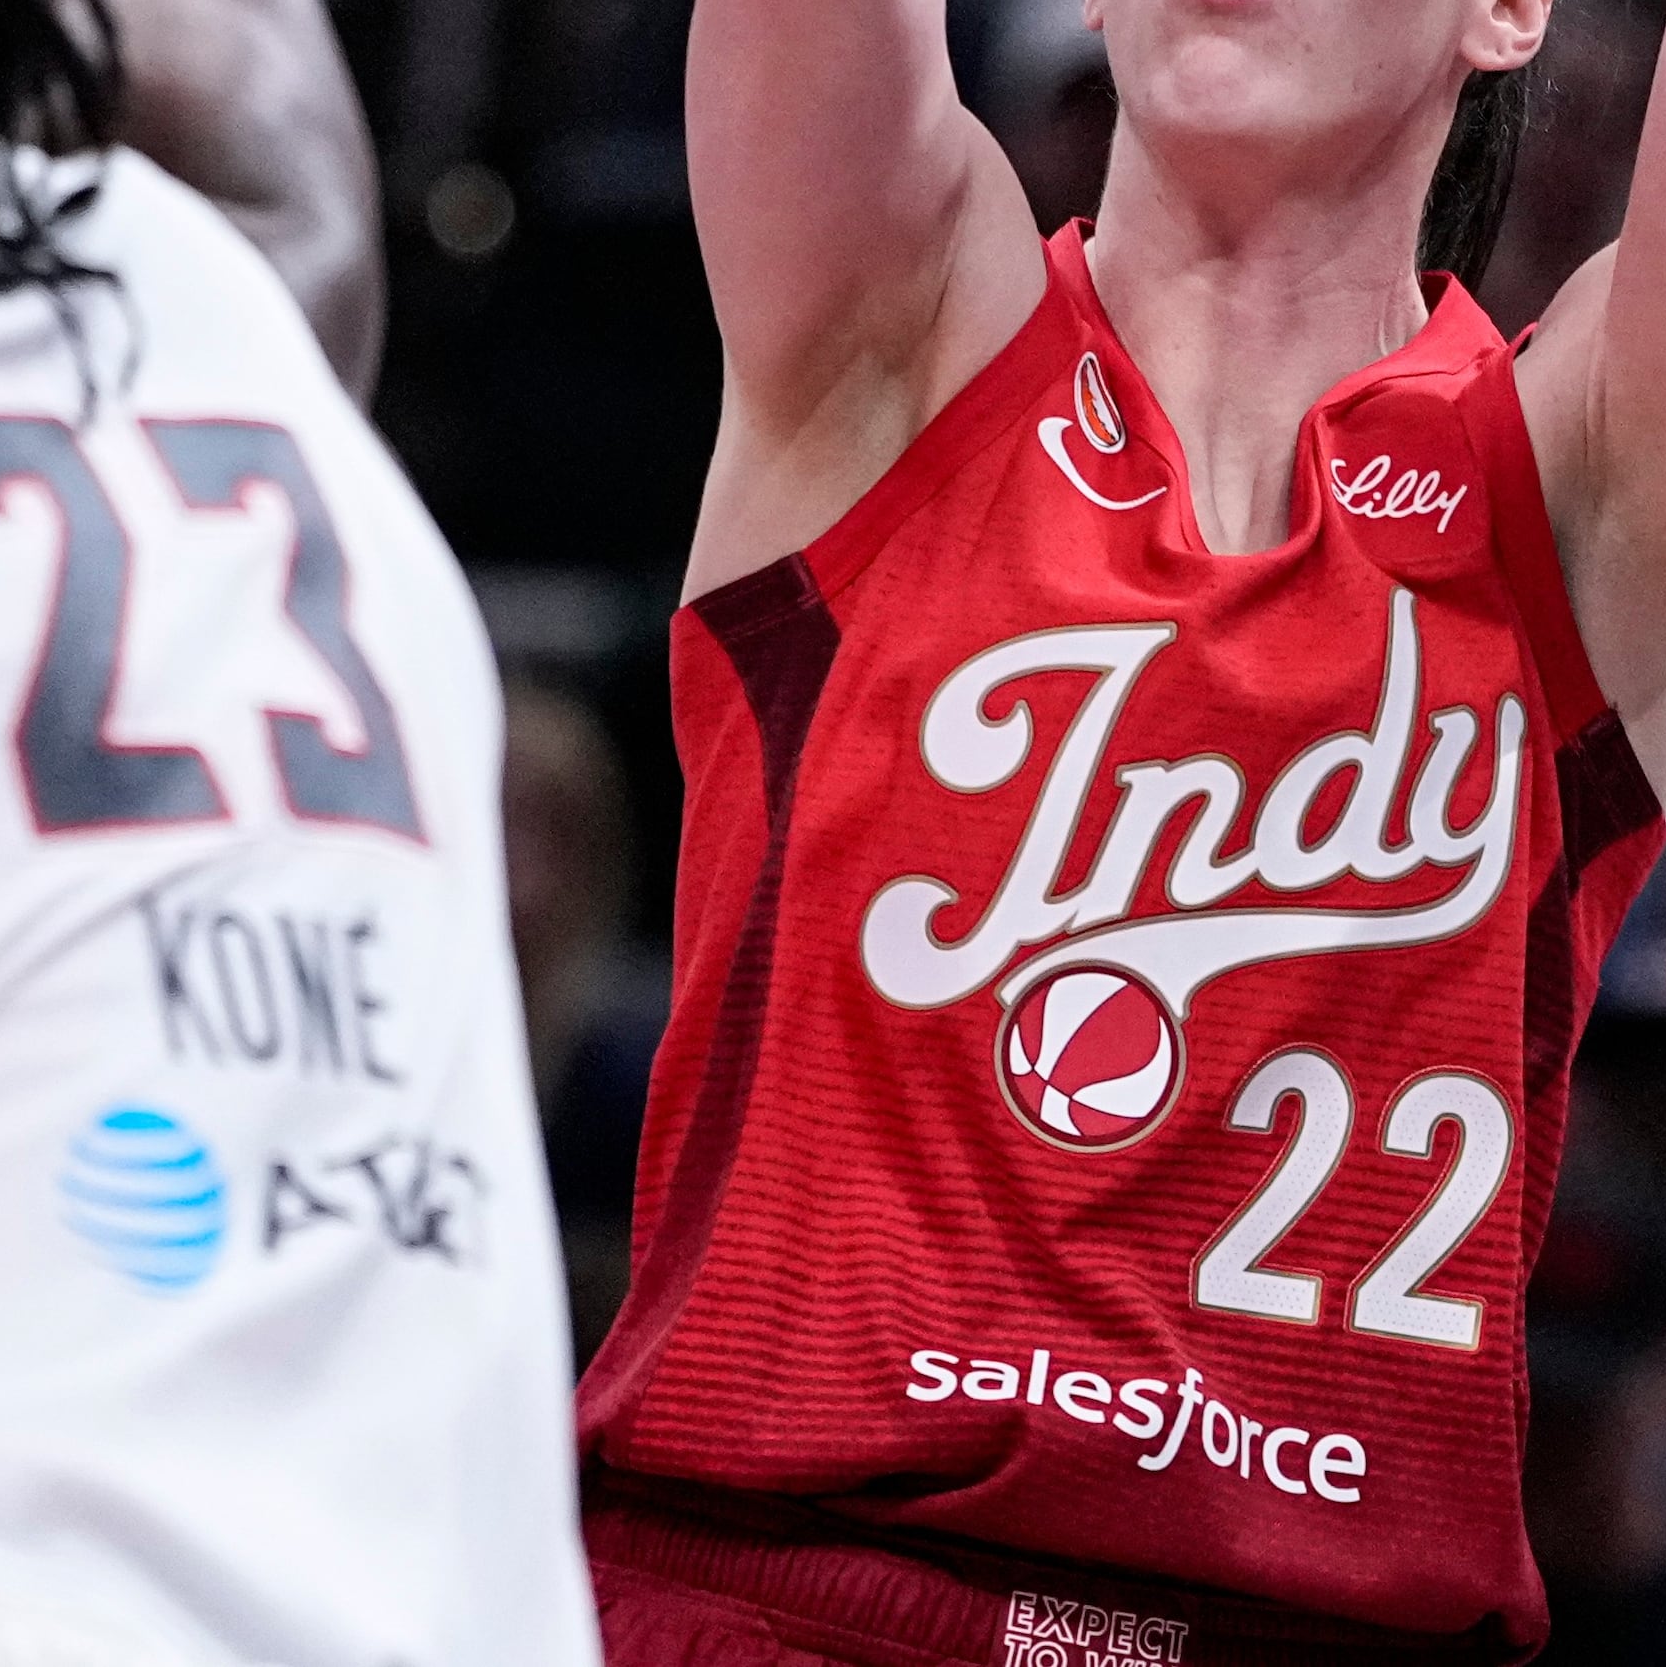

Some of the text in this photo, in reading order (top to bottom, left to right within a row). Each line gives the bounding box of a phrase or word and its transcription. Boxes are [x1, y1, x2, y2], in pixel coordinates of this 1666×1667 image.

[1330, 454, 1467, 534] Lilly
[860, 586, 1528, 1021] Indy
[1189, 1041, 1516, 1351] 22
[905, 1348, 1367, 1504] salesforce
[1003, 1632, 1069, 1667] TO
[1005, 1590, 1190, 1664] EXPECT
